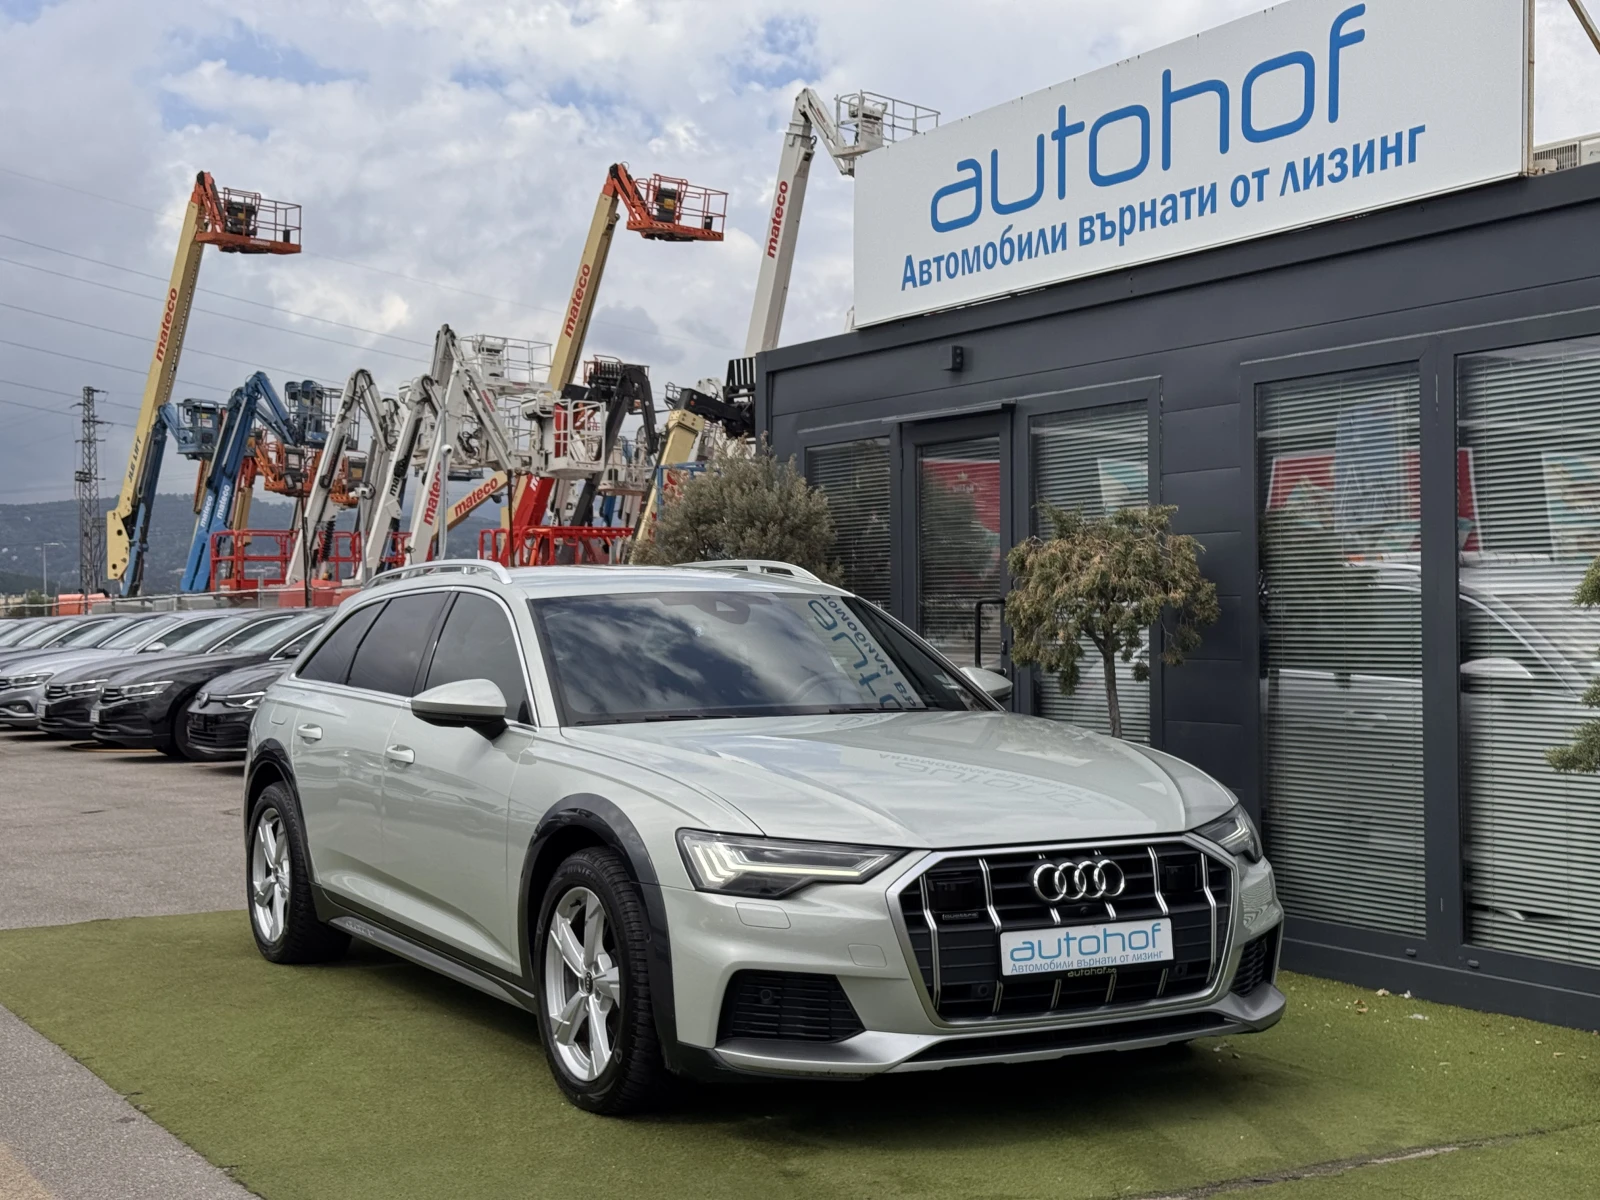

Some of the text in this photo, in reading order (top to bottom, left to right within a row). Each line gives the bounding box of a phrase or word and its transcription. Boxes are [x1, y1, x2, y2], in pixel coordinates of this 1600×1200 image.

[930, 3, 1366, 233] autohof
[767, 181, 788, 258] mateco
[901, 124, 1425, 291] Автомобили върнати от лизинг
[564, 264, 590, 338] mateco
[156, 288, 177, 362] mateco
[128, 436, 142, 483] JLG LIFT
[200, 495, 213, 528] mateco
[216, 484, 230, 519] mateco
[454, 477, 499, 517] mateco
[1010, 922, 1161, 962] autohof
[1011, 951, 1163, 974] Автомобили върнати от лизинг
